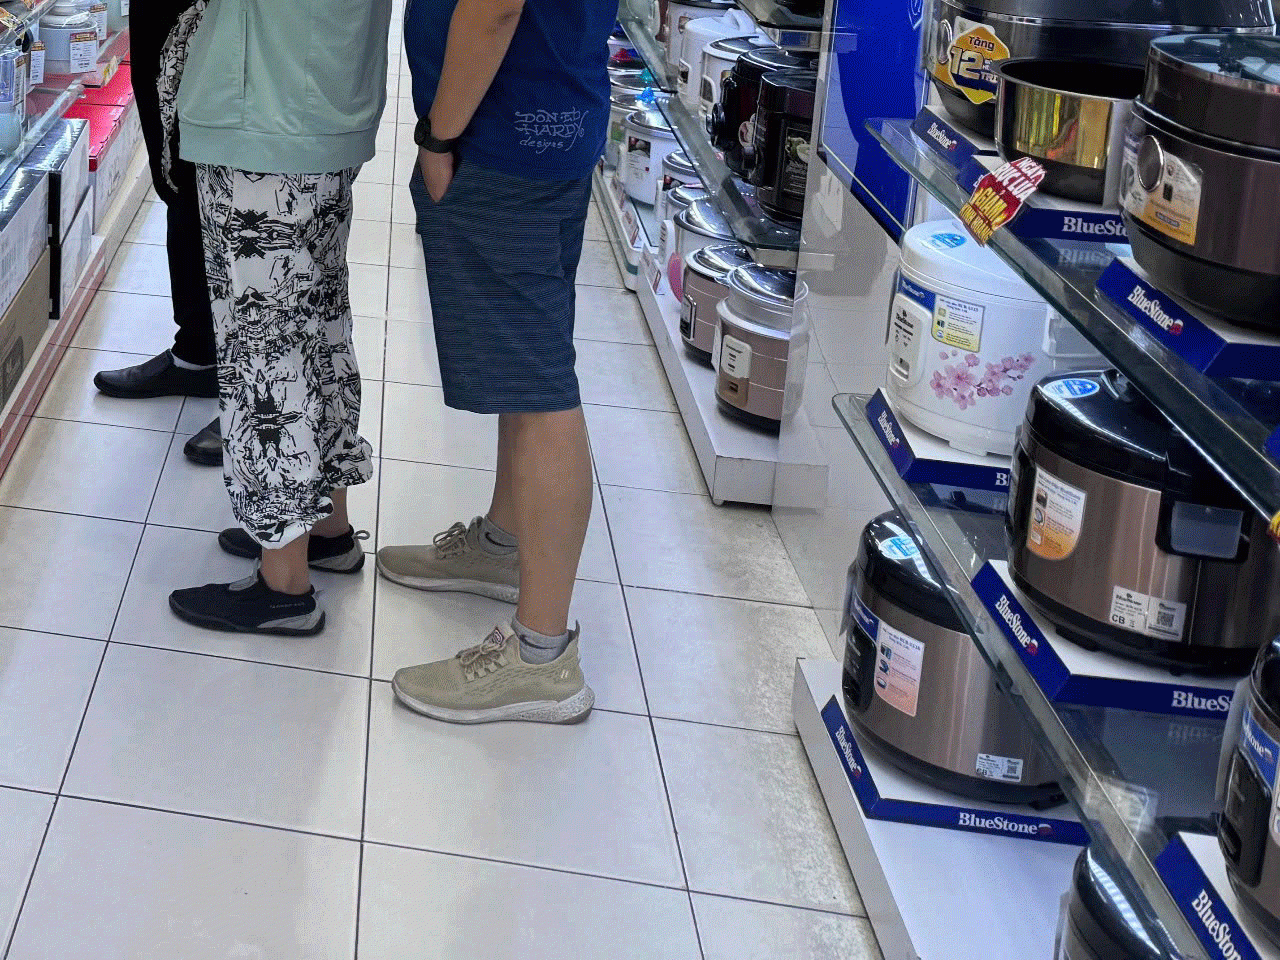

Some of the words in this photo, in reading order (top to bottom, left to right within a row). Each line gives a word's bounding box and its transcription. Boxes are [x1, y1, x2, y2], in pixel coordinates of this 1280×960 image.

[969, 36, 995, 52] Tặng
[950, 46, 984, 80] 12
[927, 122, 952, 151] BlueStone
[1127, 284, 1175, 332] BlueStone
[878, 410, 896, 445] BlueStone
[995, 594, 1030, 648] BlueStone
[1172, 691, 1232, 712] BlueS
[835, 725, 856, 777] BlueStone
[958, 811, 1038, 836] BlueStone
